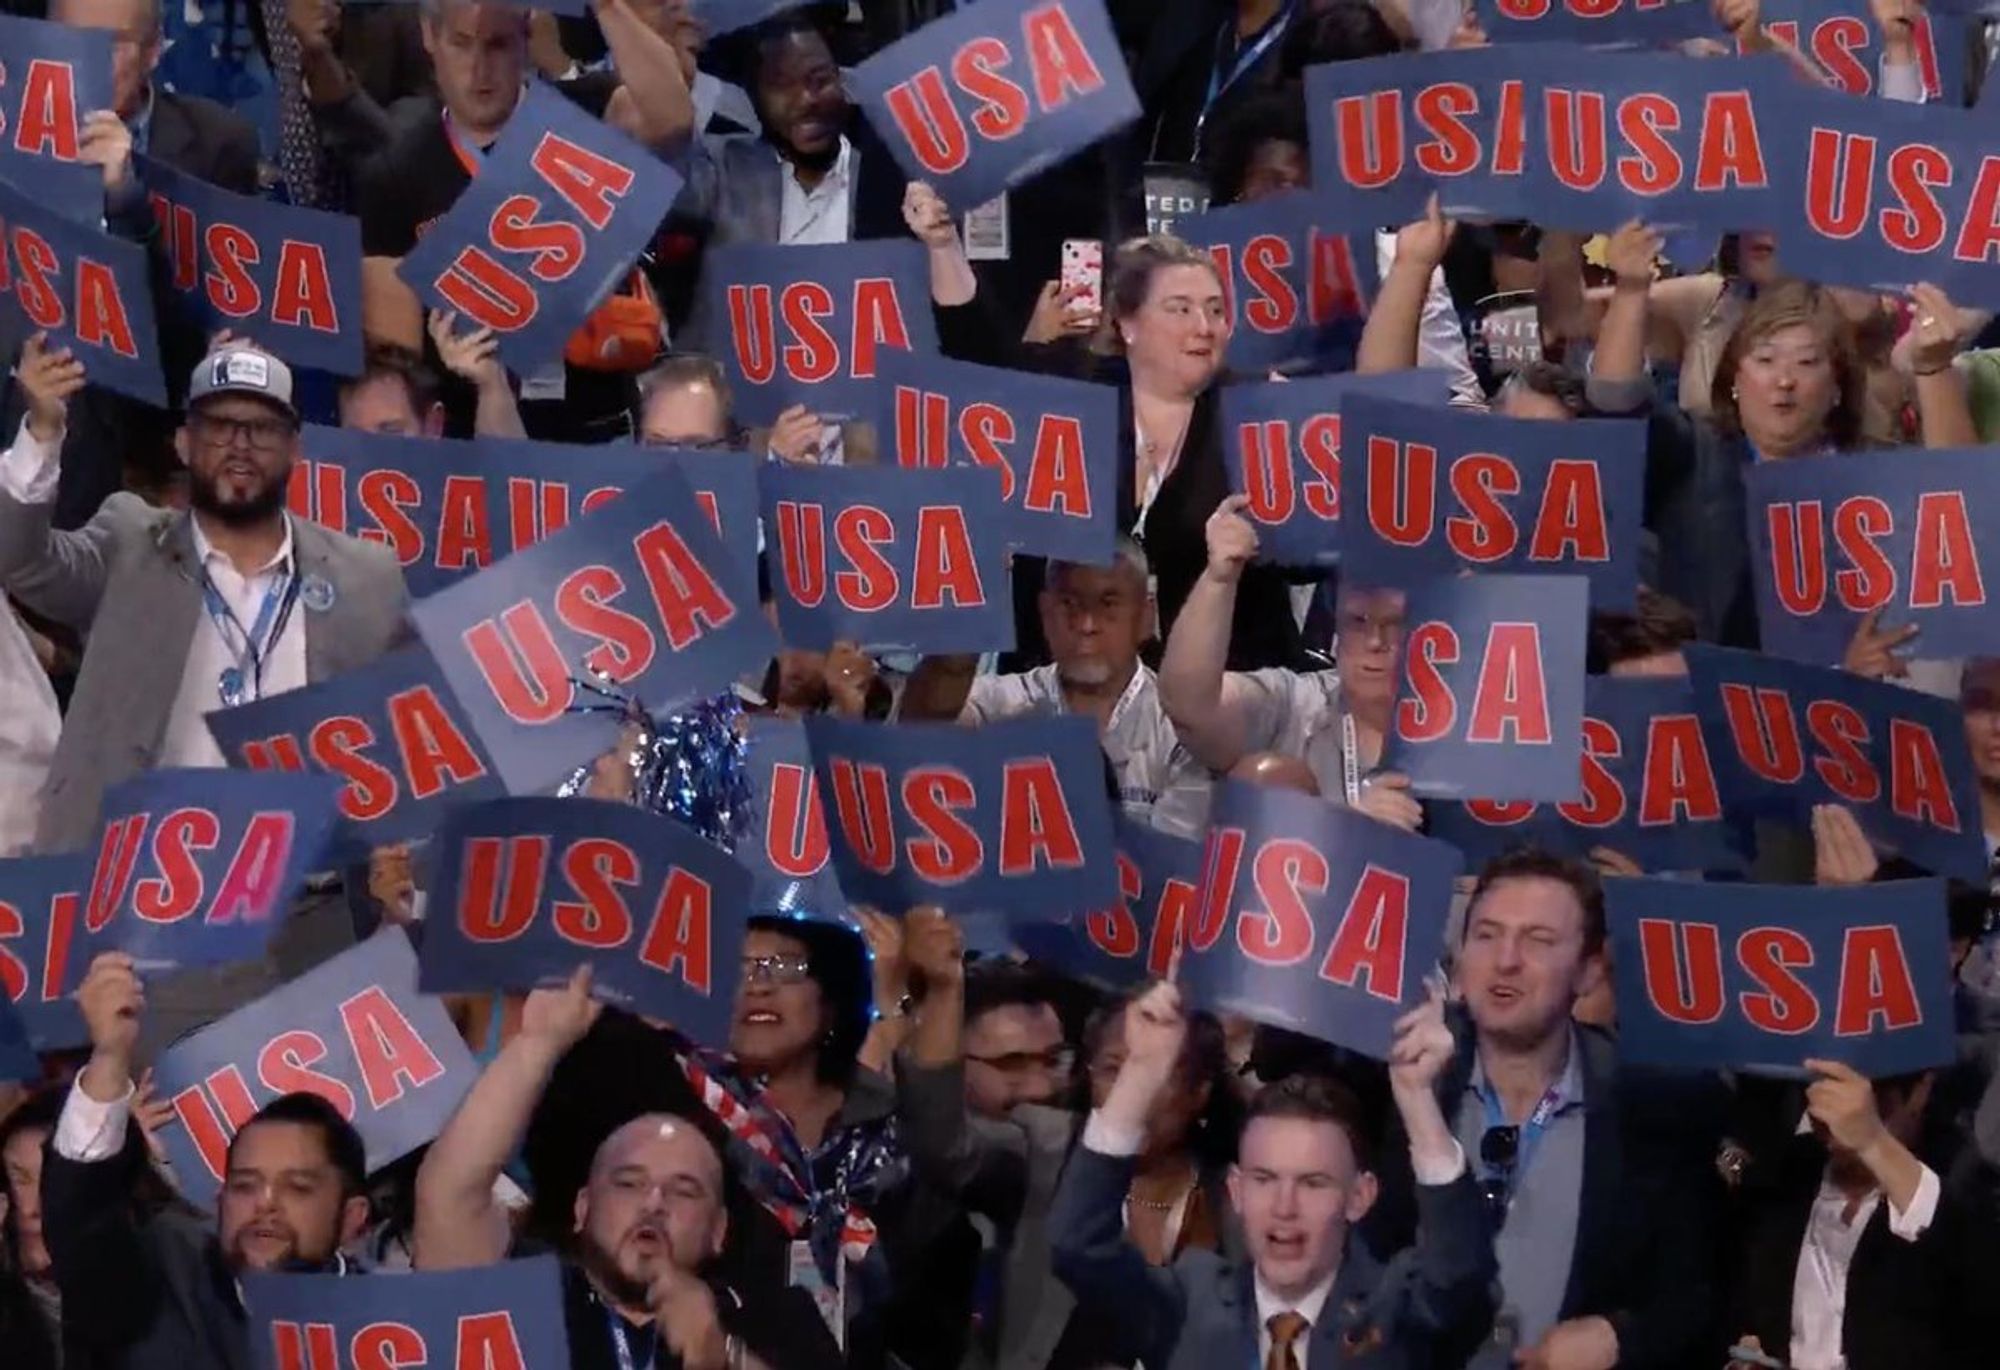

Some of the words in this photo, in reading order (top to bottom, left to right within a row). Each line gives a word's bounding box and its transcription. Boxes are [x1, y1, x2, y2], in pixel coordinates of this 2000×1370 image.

[0, 59, 78, 162] A
[884, 3, 1104, 174] USA
[1545, 87, 1767, 195] USA
[0, 214, 138, 359] SA
[433, 131, 635, 332] USA
[728, 278, 912, 384] USA
[776, 501, 987, 612] USA
[1368, 435, 1610, 563] USA
[1767, 490, 1986, 616] USA
[462, 519, 737, 725] USA
[829, 755, 1085, 887] USA
[1719, 682, 1960, 833] USA
[86, 807, 297, 933] USA
[457, 835, 712, 997] USA
[1184, 826, 1410, 1003] USA
[1639, 918, 1922, 1036] USA
